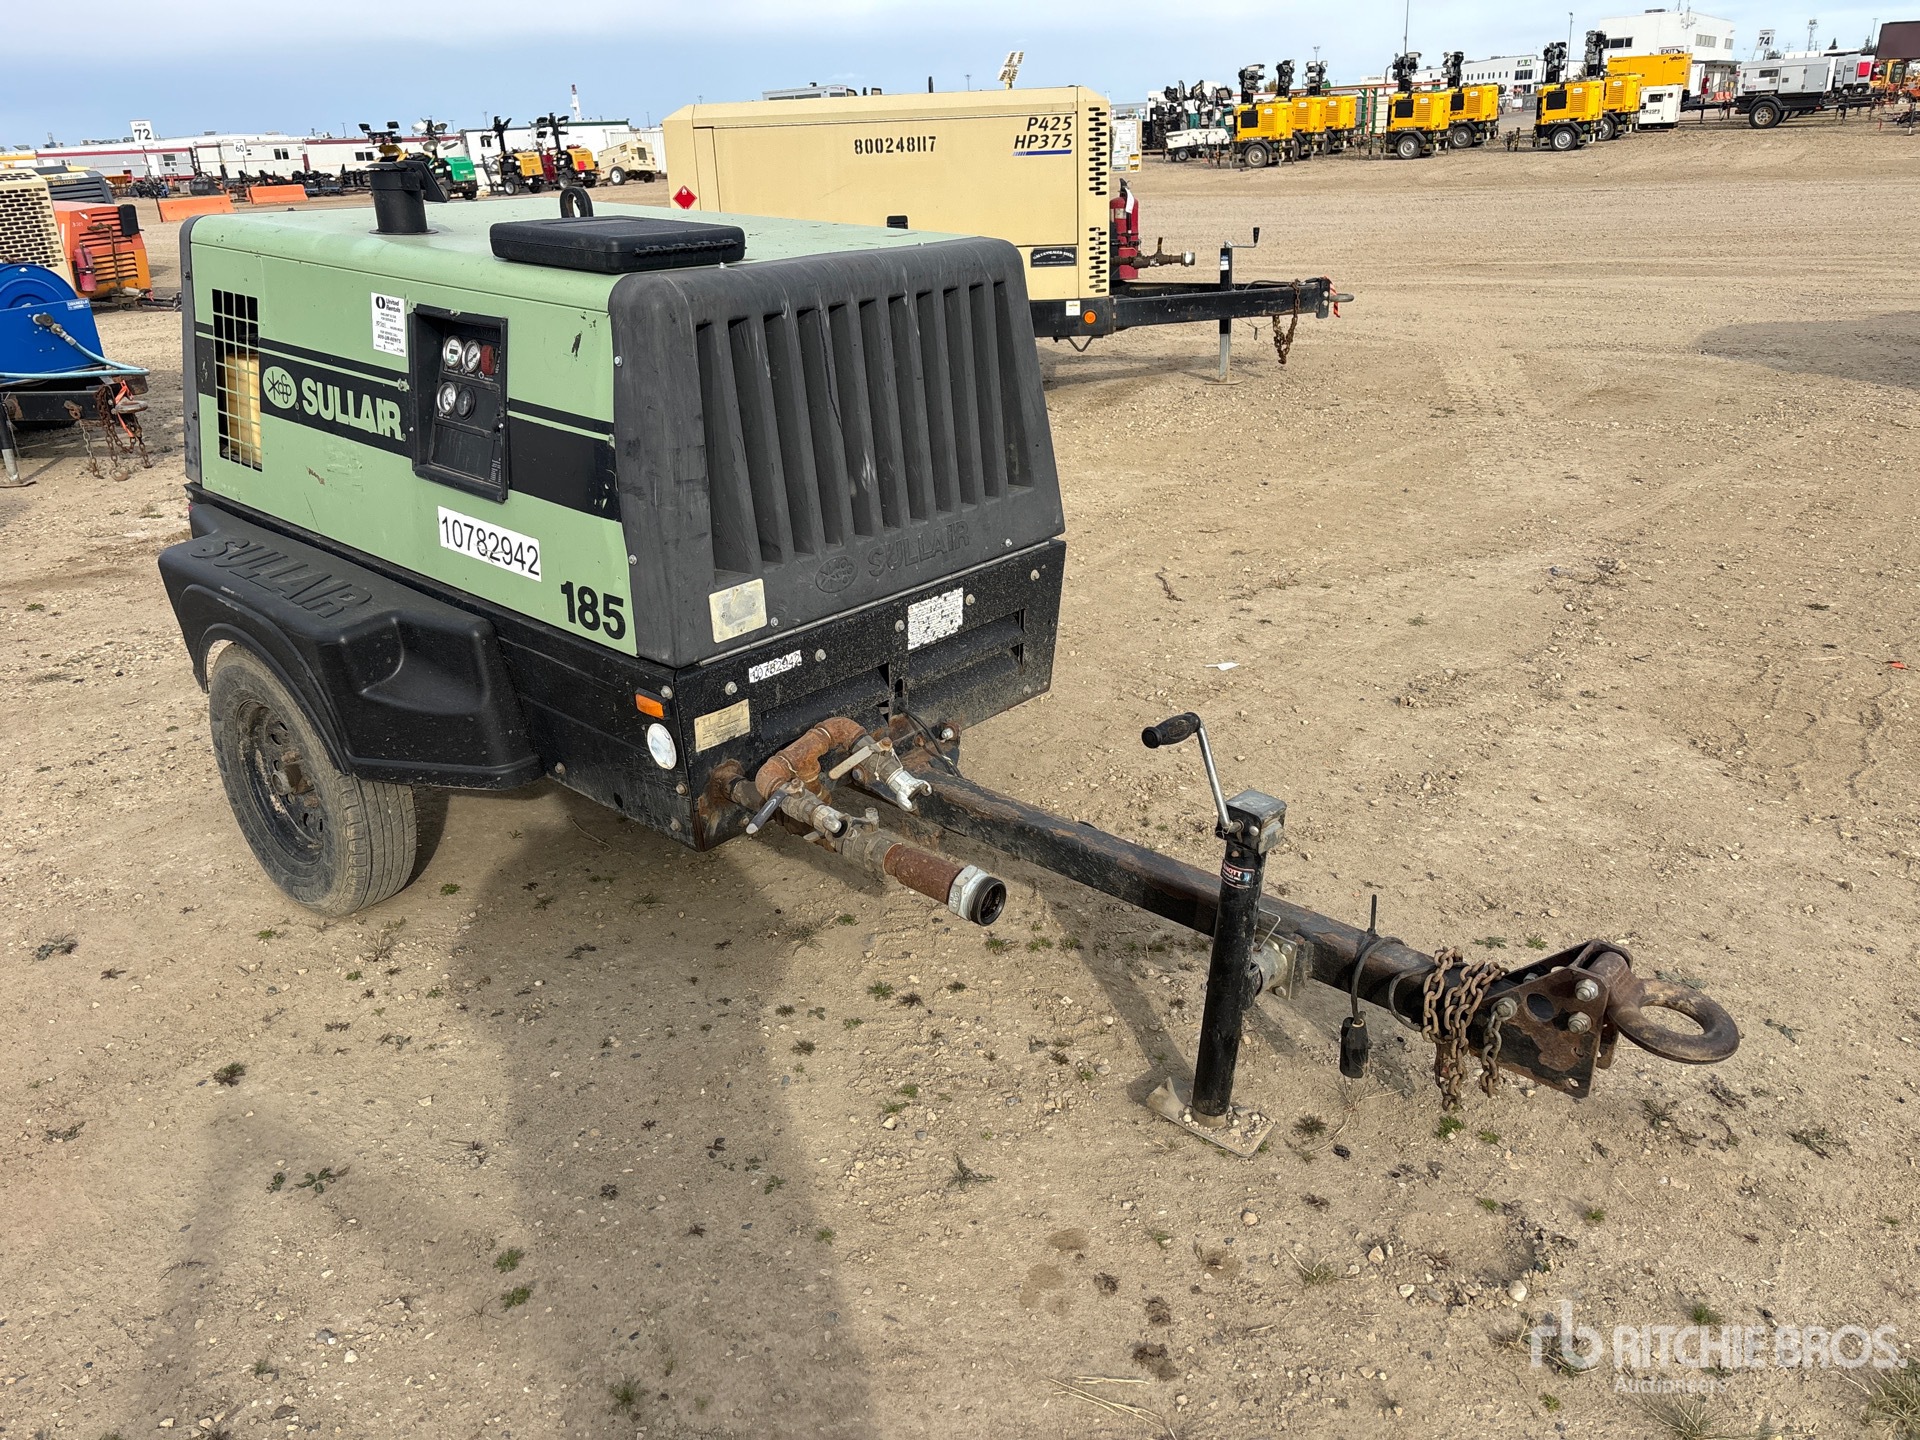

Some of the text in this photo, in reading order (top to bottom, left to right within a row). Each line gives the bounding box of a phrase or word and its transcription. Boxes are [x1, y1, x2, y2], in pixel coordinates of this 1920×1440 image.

[1759, 36, 1770, 46] 74
[1026, 116, 1073, 132] P425
[133, 128, 152, 141] 72
[1014, 133, 1073, 150] HP375
[235, 144, 245, 153] 60
[854, 136, 937, 155] 800248117
[301, 377, 404, 441] SULLAIR
[442, 516, 540, 576] 10782942
[868, 520, 970, 577] SULLAIR
[190, 539, 373, 619] SULLAIR
[560, 580, 626, 640] 185
